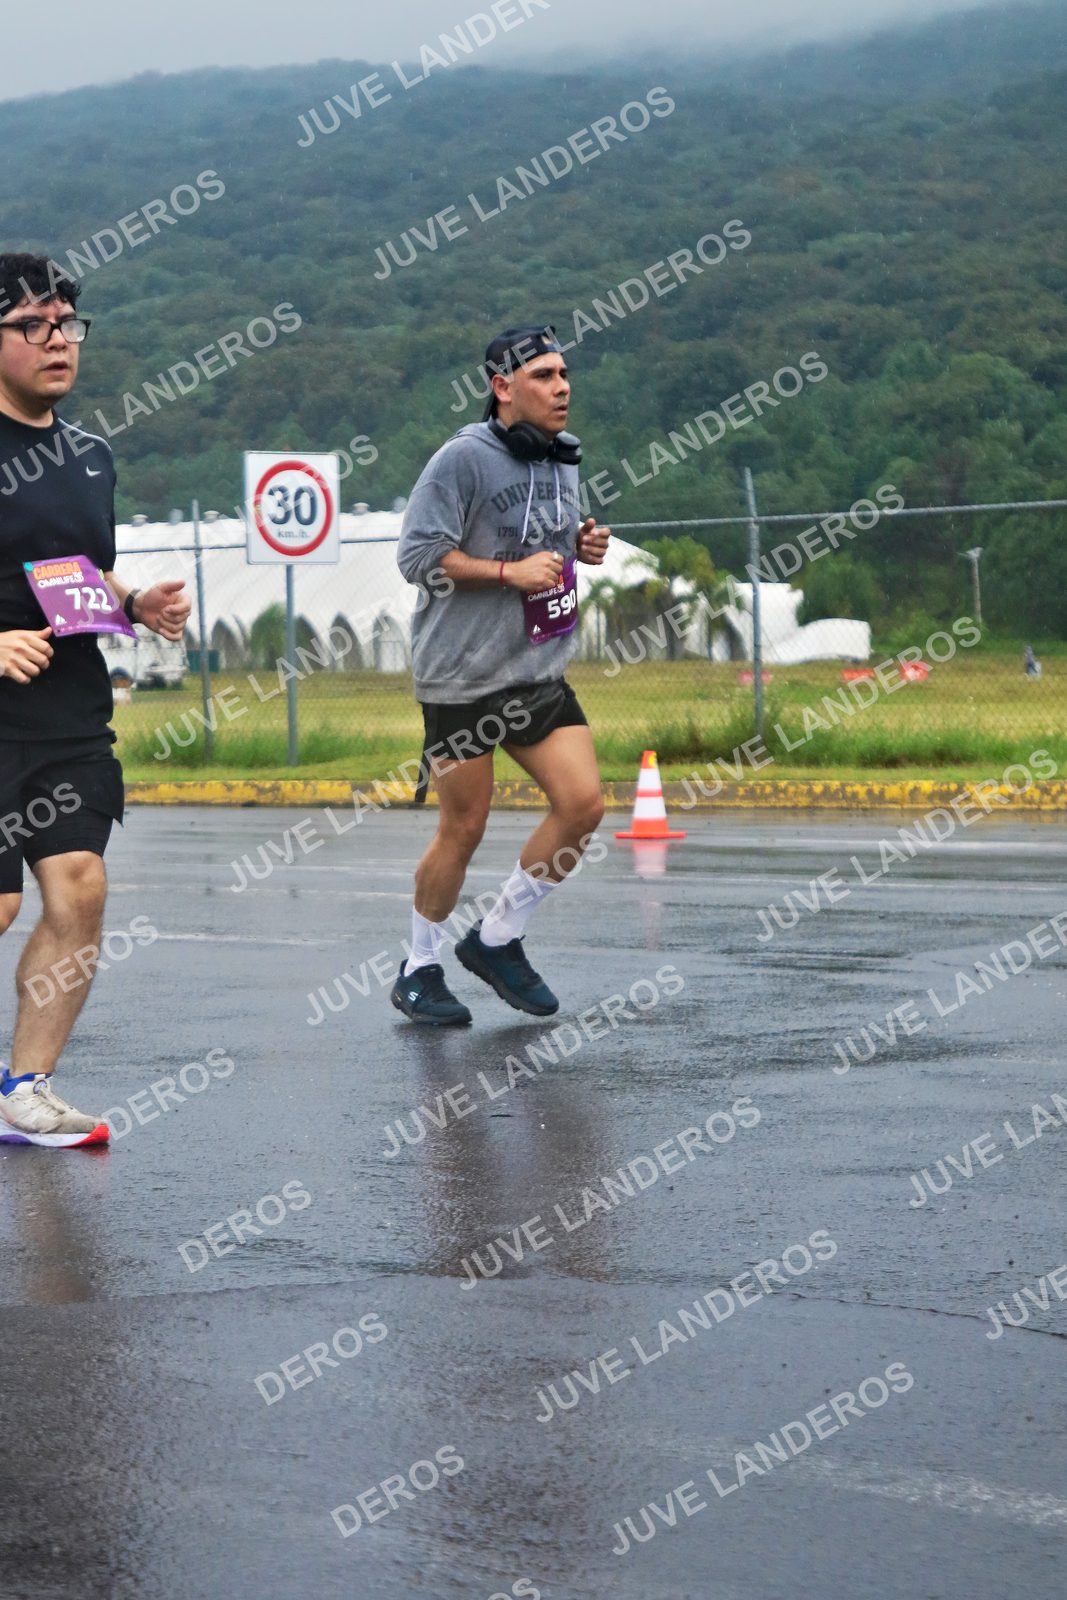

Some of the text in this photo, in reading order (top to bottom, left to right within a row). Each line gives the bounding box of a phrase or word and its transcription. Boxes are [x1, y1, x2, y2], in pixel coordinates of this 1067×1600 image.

[268, 485, 318, 525] 30
[33, 562, 81, 580] CARRERA
[65, 587, 112, 611] 722
[547, 589, 576, 619] 590
